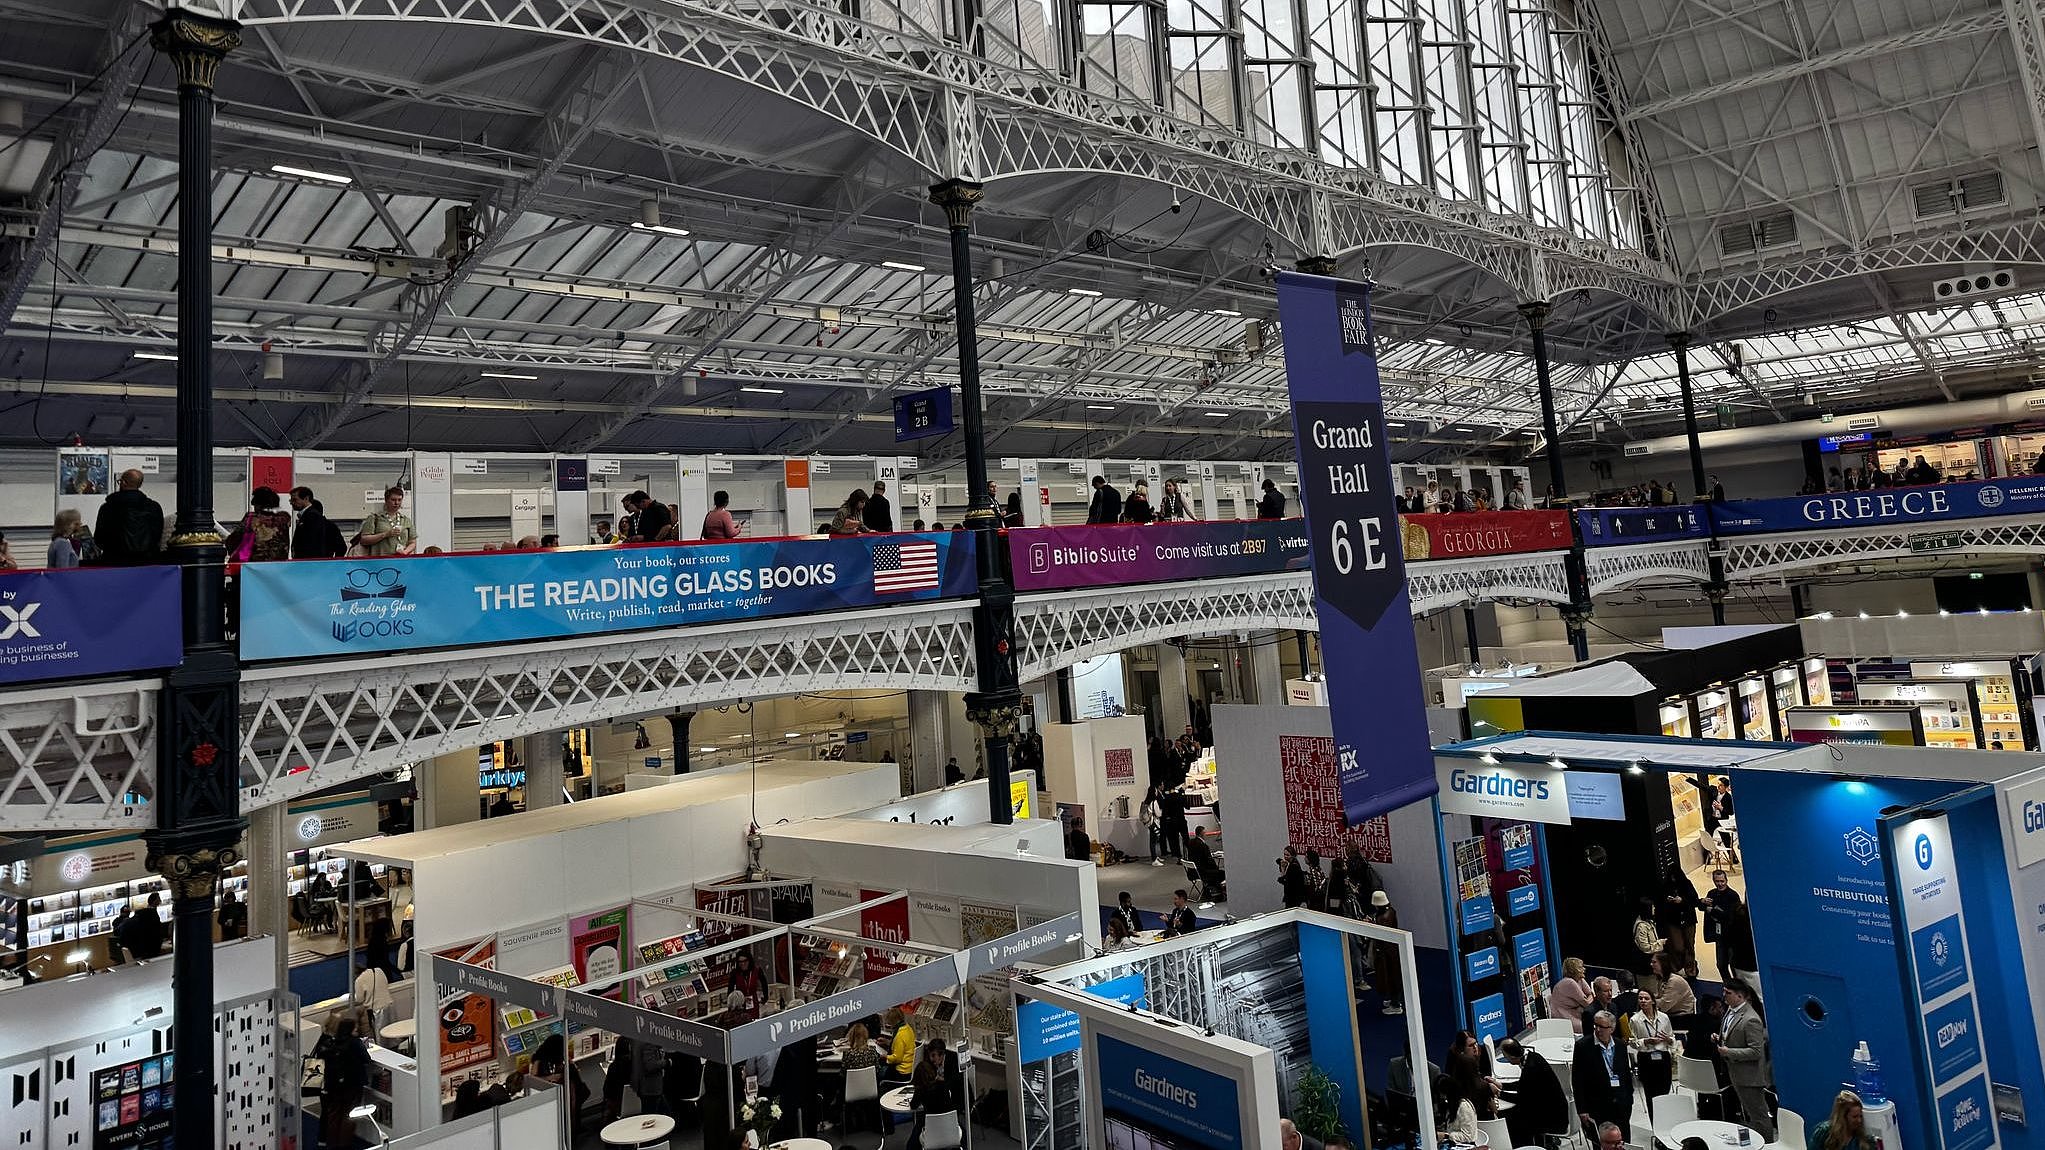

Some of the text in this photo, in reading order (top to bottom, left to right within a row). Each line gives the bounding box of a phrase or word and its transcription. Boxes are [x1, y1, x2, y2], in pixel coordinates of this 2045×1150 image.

[1341, 307, 1364, 318] LONDON
[1345, 299, 1358, 309] THE
[1342, 315, 1366, 331] BOOK
[1344, 329, 1368, 345] FAIR
[1312, 419, 1373, 449] Grand
[881, 467, 895, 478] JCA
[1327, 463, 1370, 494] Hall
[2009, 486, 2039, 494] HELLENIC
[1803, 490, 1950, 522] GREECE
[1155, 539, 1267, 560] Come visit us at 2B97
[1331, 517, 1386, 575] 6 E
[1444, 531, 1513, 553] GEORGIA
[613, 553, 730, 570] Your book, our stores
[3, 591, 16, 600] by
[474, 563, 836, 611] THE READING GLASS BOOKS
[348, 601, 387, 619] Reading
[390, 600, 416, 618] Glass
[566, 608, 606, 622] Write,
[608, 605, 654, 622] publish,
[658, 602, 685, 615] read,
[687, 599, 724, 610] market
[735, 593, 773, 608] together
[7, 641, 67, 654] business of
[21, 650, 79, 662] businesses
[1450, 768, 1549, 800] Gardners
[772, 886, 813, 904] SPARTA
[1813, 887, 1883, 905] DISTRIBUTION
[540, 926, 562, 938] PRESS
[1003, 940, 1031, 958] Profile
[1031, 930, 1057, 947] Books
[575, 1002, 598, 1018] Books
[789, 1005, 828, 1033] Profile
[828, 998, 863, 1020] Books
[1479, 1010, 1502, 1024] Gardners
[1135, 1068, 1197, 1109] Gardners
